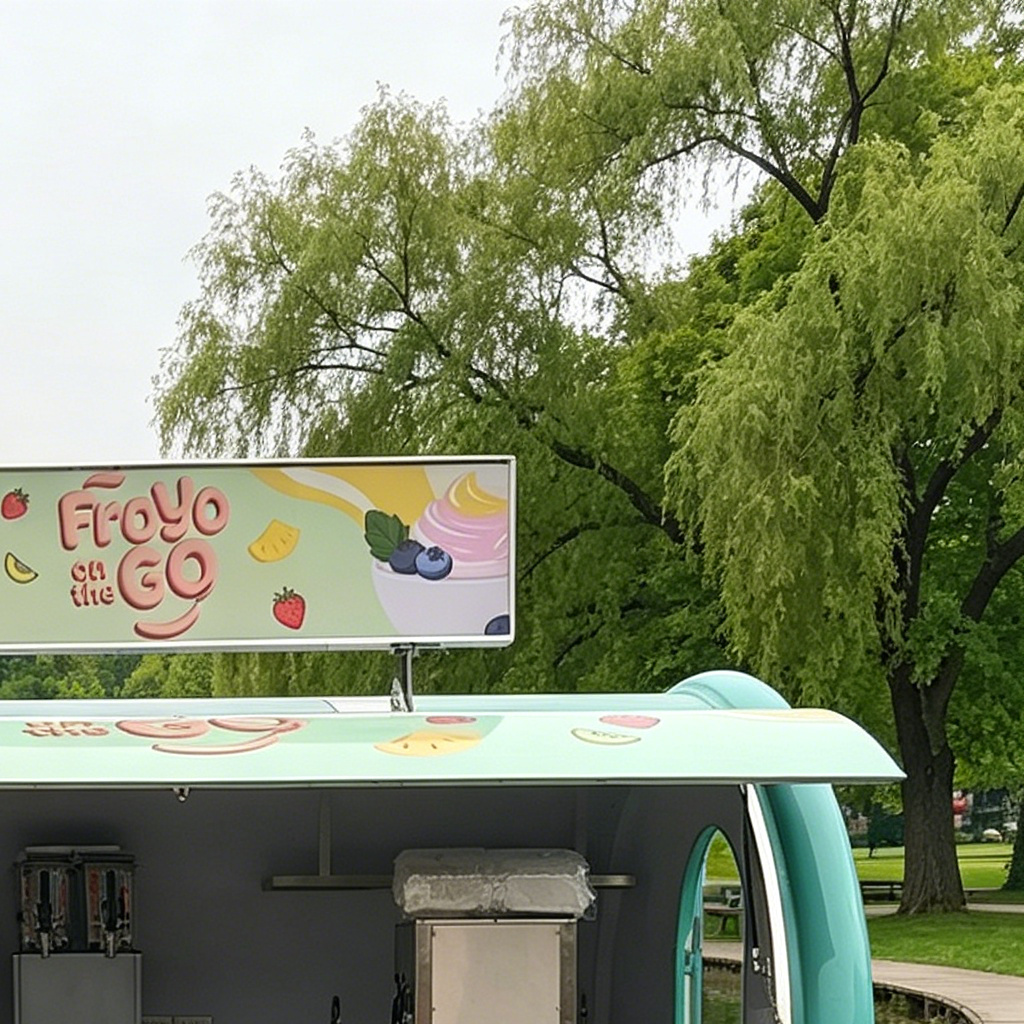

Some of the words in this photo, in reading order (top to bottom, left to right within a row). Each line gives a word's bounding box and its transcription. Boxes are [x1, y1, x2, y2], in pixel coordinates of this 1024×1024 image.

[58, 475, 230, 551] Froyo
[70, 582, 115, 608] the
[71, 561, 107, 582] on
[117, 537, 220, 612] GO
